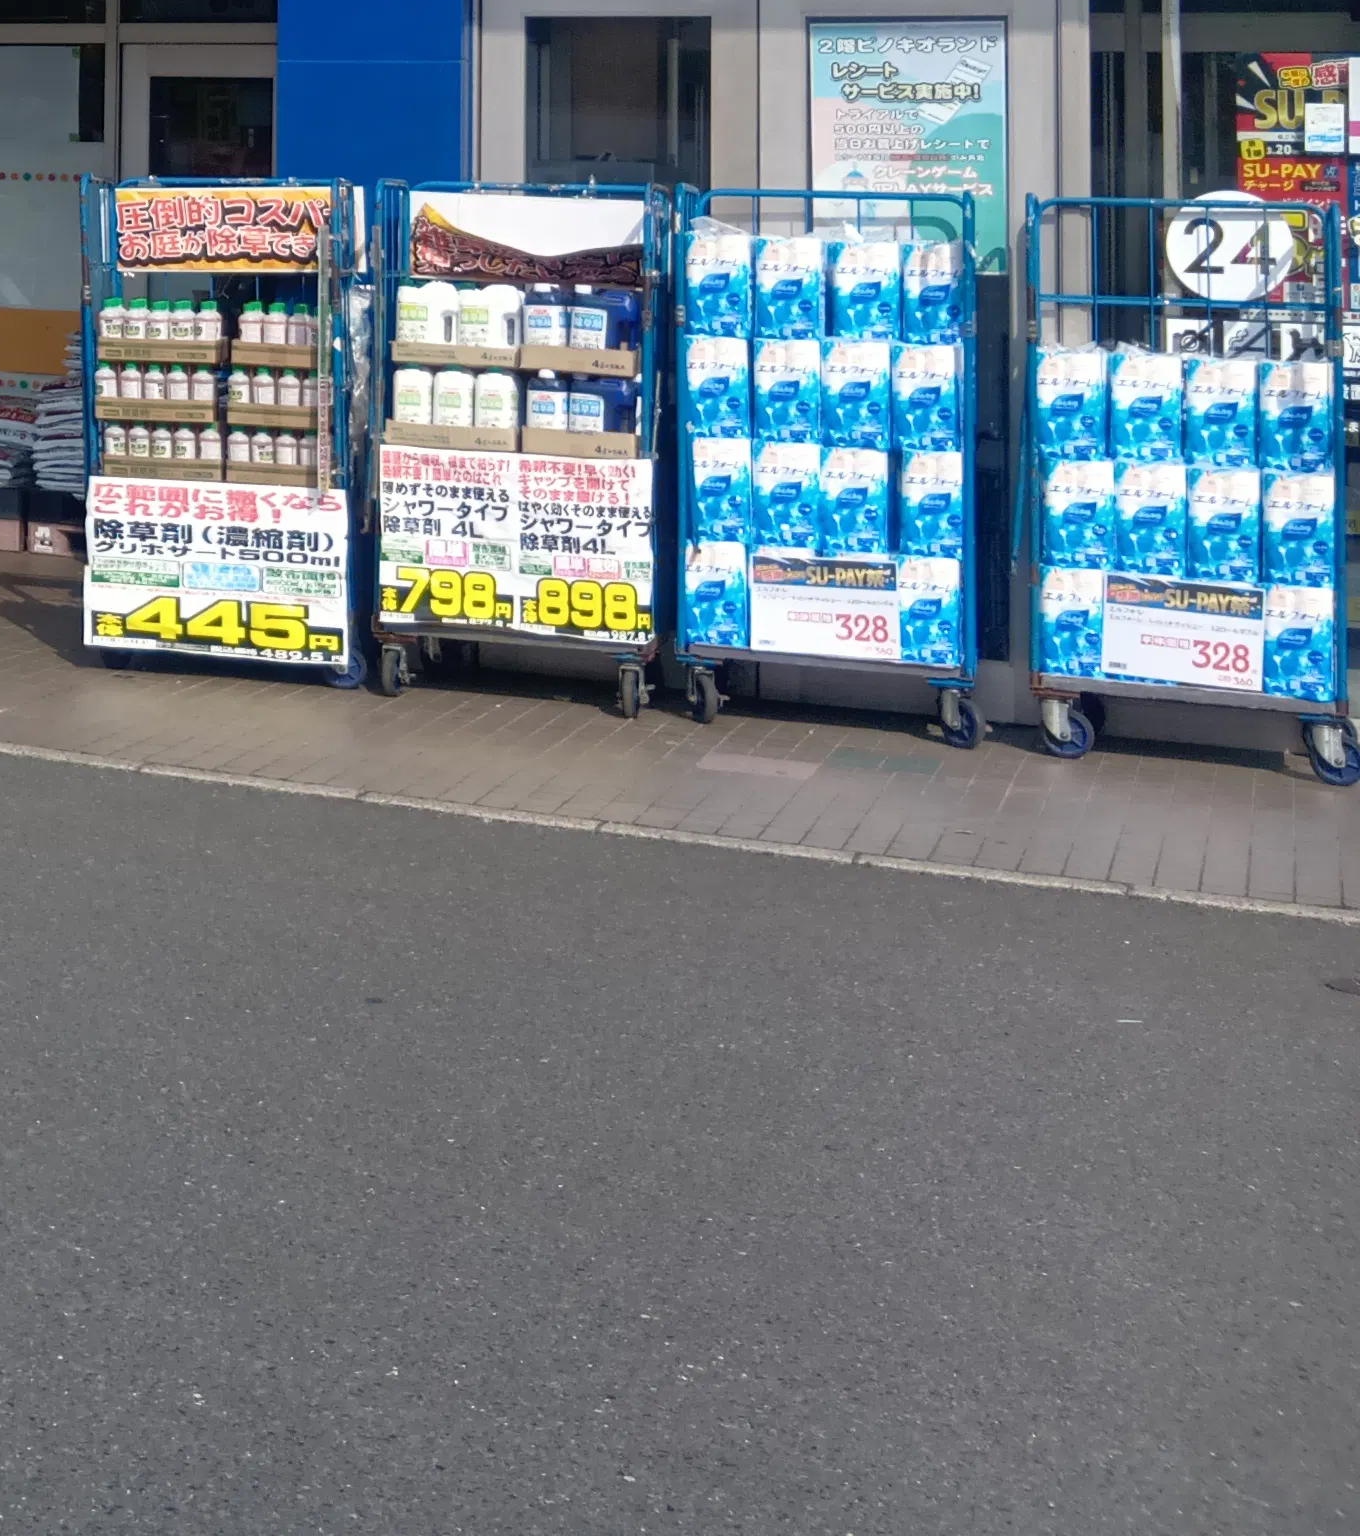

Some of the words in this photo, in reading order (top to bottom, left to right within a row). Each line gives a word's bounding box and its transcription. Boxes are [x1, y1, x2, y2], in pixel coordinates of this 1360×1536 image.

[831, 61, 899, 79] レシート
[835, 108, 919, 120] トライアルで
[834, 124, 925, 135] 500円以上の
[874, 165, 978, 178] クレーンゲーム
[1243, 163, 1321, 178] SU-PAY
[1243, 180, 1294, 191] チャージ
[1184, 217, 1277, 275] 24
[382, 481, 510, 503] 薄めずそのまま使える
[382, 497, 509, 522] シャワータイプ
[383, 515, 441, 537] 除草剤
[451, 521, 484, 539] 4L
[396, 566, 497, 619] 798
[536, 577, 638, 631] 898
[125, 595, 310, 651] 445
[835, 614, 889, 643] 328
[1192, 640, 1250, 673] 328
